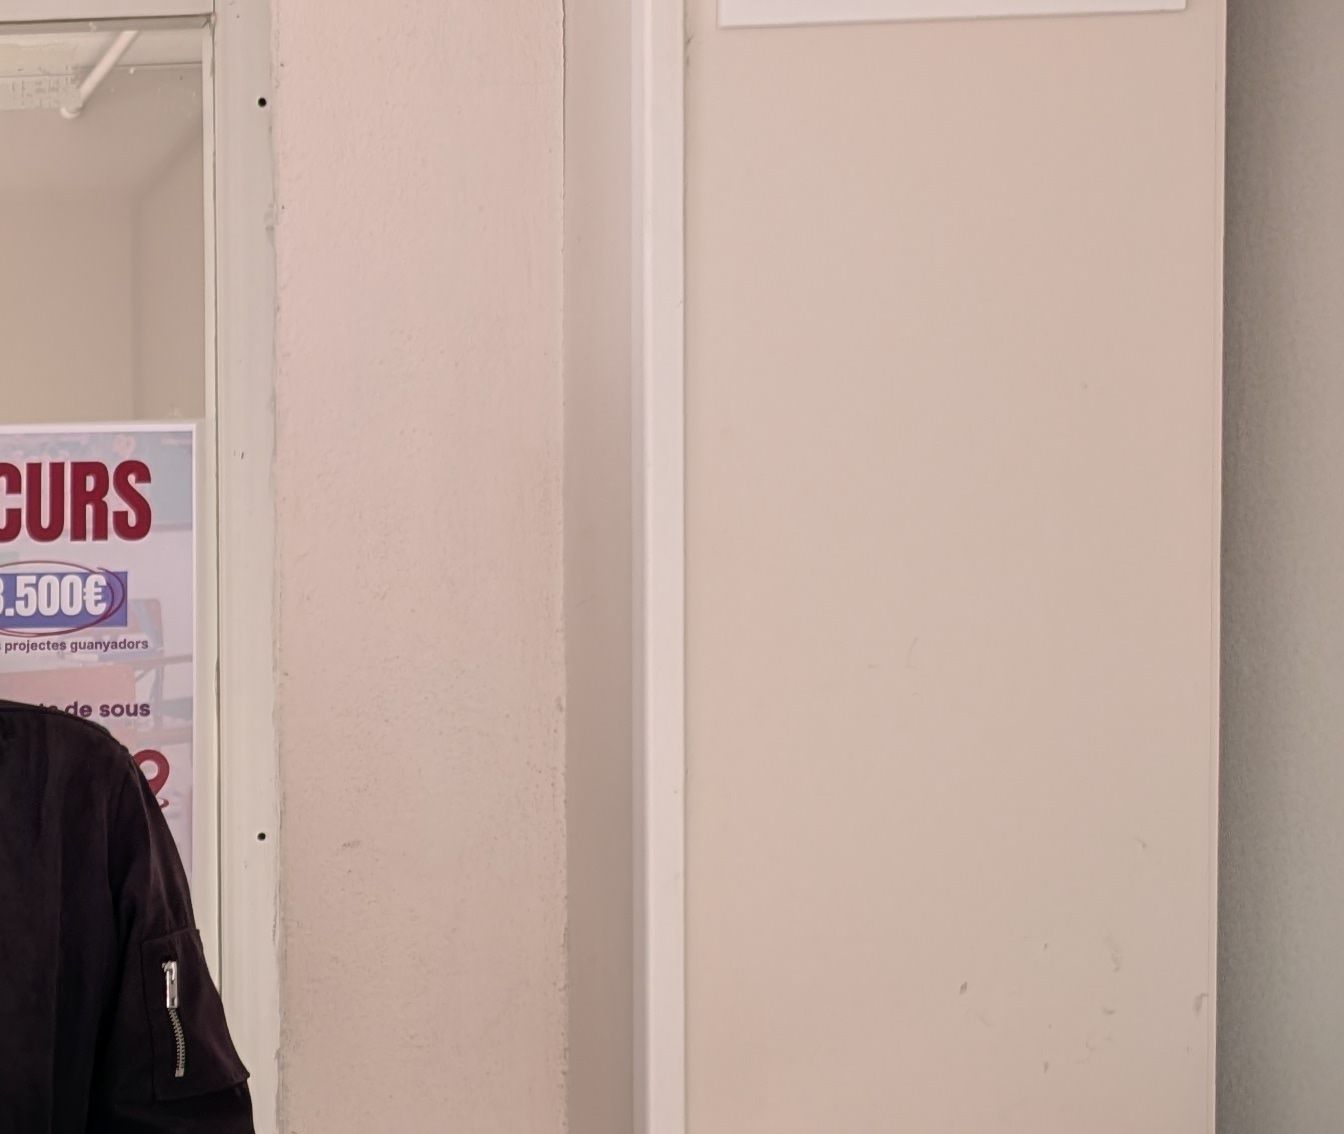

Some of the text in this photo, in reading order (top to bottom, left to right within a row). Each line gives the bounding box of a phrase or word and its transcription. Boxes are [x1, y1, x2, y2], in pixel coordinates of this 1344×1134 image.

[4, 639, 66, 655] projectes
[70, 638, 149, 655] guanyadors
[64, 701, 93, 717] de
[99, 703, 151, 717] sous
